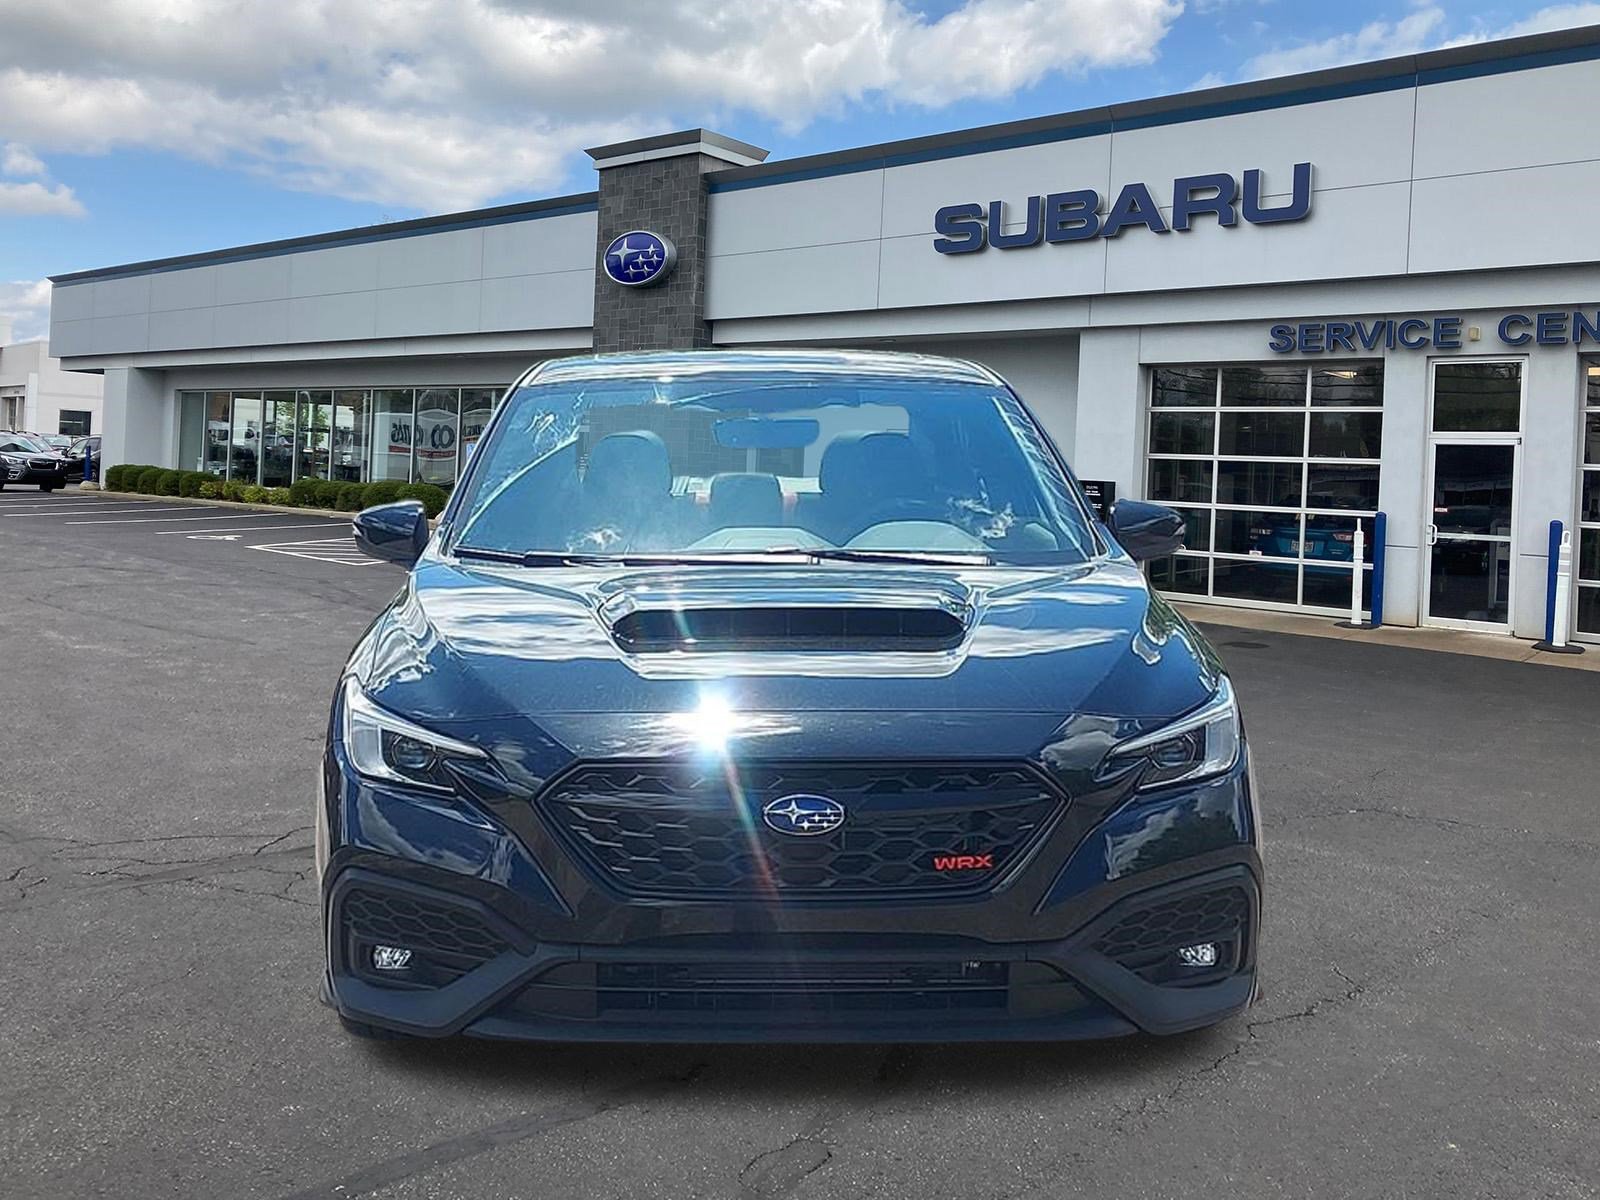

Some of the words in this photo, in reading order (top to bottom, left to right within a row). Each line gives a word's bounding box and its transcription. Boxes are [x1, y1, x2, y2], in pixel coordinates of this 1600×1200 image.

[933, 161, 1313, 256] SUBARU
[1269, 316, 1463, 353] SERVICE
[934, 854, 993, 871] WRX
